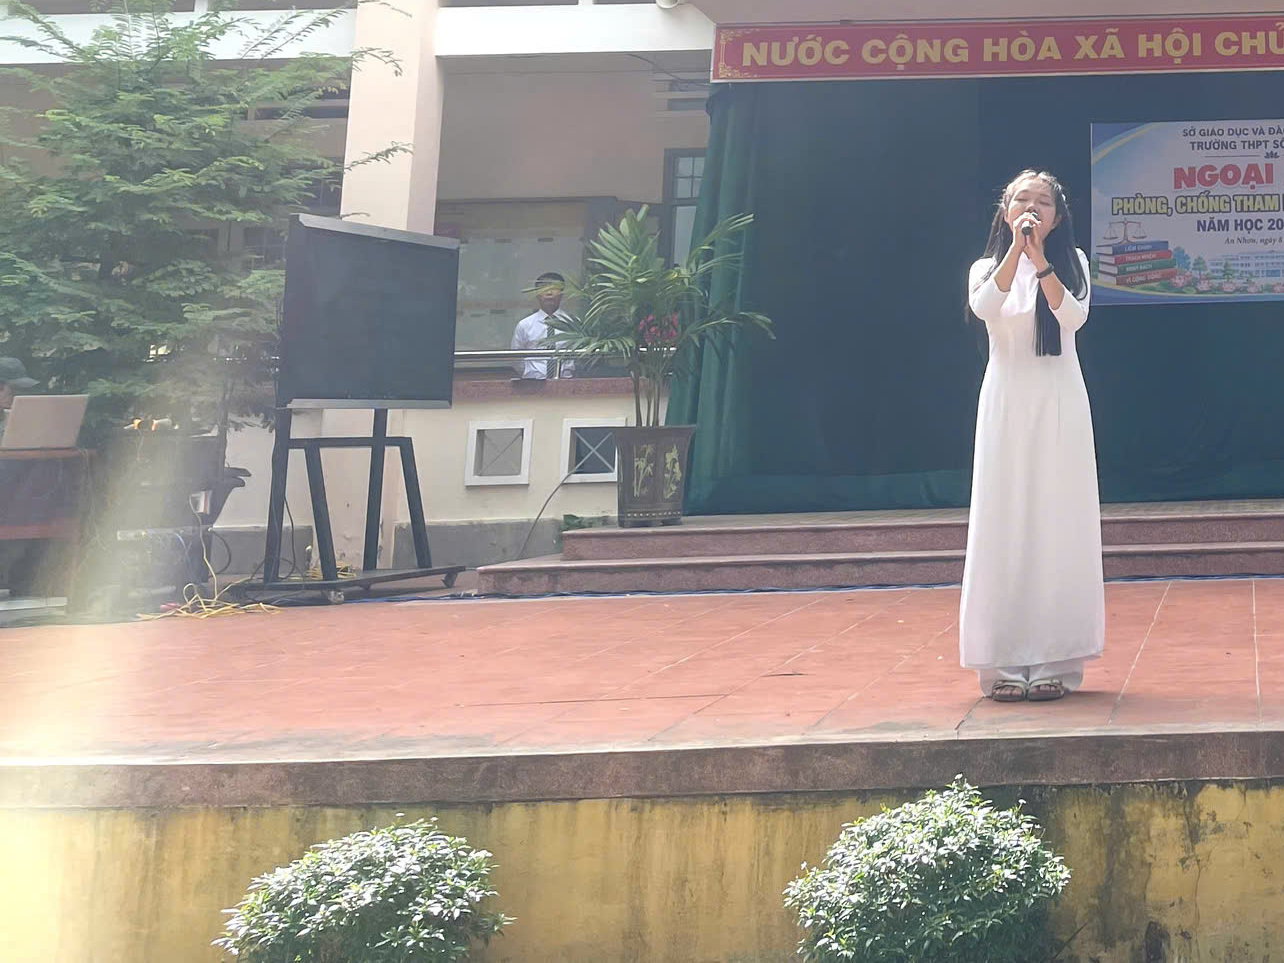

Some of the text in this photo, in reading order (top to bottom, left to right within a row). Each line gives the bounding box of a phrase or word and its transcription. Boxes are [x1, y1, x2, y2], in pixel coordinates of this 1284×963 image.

[743, 34, 849, 66] NƯỚC
[861, 33, 969, 70] CỘNG
[983, 30, 1062, 61] HÒA
[1073, 27, 1125, 59] XÃ
[1138, 27, 1202, 64] HỘI
[1182, 126, 1196, 137] SỞ
[1199, 126, 1225, 137] GIÁO
[1227, 127, 1249, 138] DỤC
[1252, 125, 1265, 136] VÀ
[1189, 138, 1237, 151] TRƯỜNG
[1241, 140, 1270, 150] THPT
[1173, 163, 1275, 190] NGOẠI
[1112, 193, 1173, 216] PHÒNG,
[1175, 191, 1232, 214] CHỐNG
[1233, 194, 1280, 213] THAM
[1197, 218, 1229, 232] NĂM
[1234, 219, 1264, 234] HỌC
